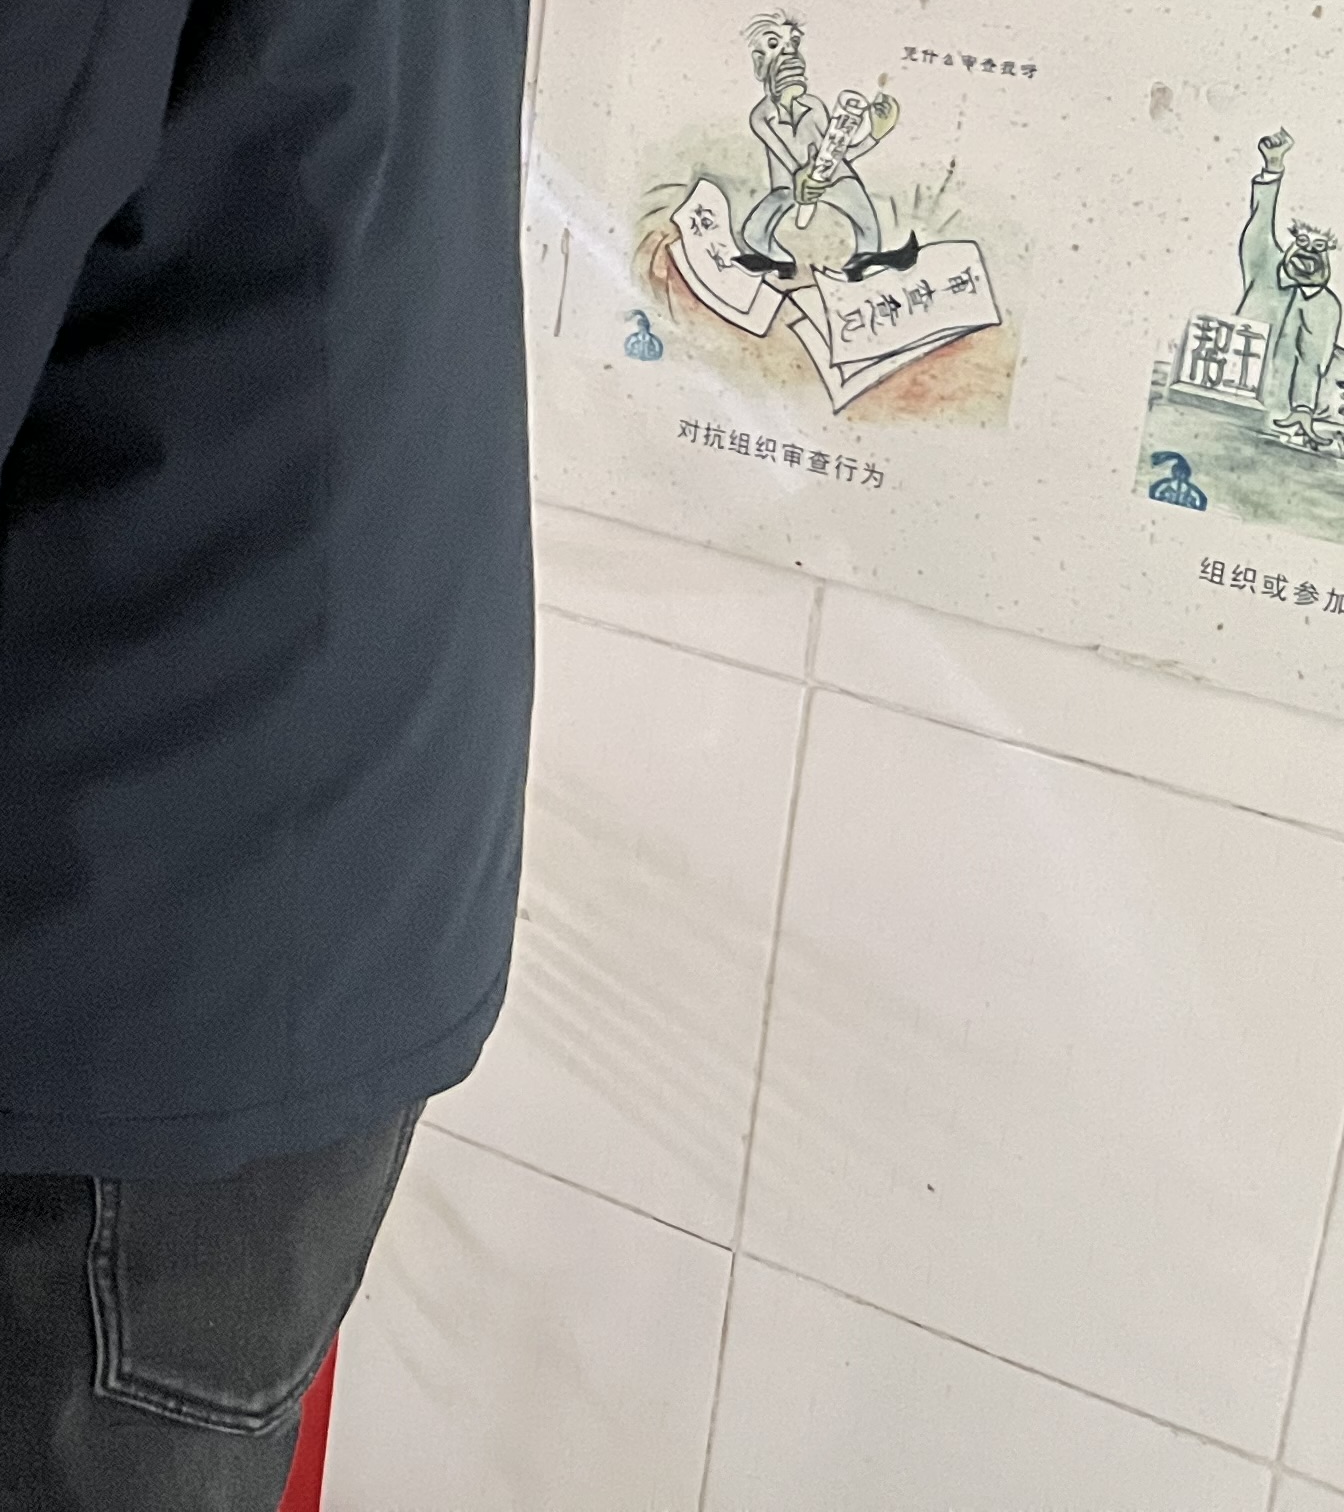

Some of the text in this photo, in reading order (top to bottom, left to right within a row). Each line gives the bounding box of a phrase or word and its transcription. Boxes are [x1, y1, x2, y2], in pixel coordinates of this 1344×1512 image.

[677, 419, 885, 489] 对抗组织审查行为
[1198, 556, 1344, 615] 组织或参加
